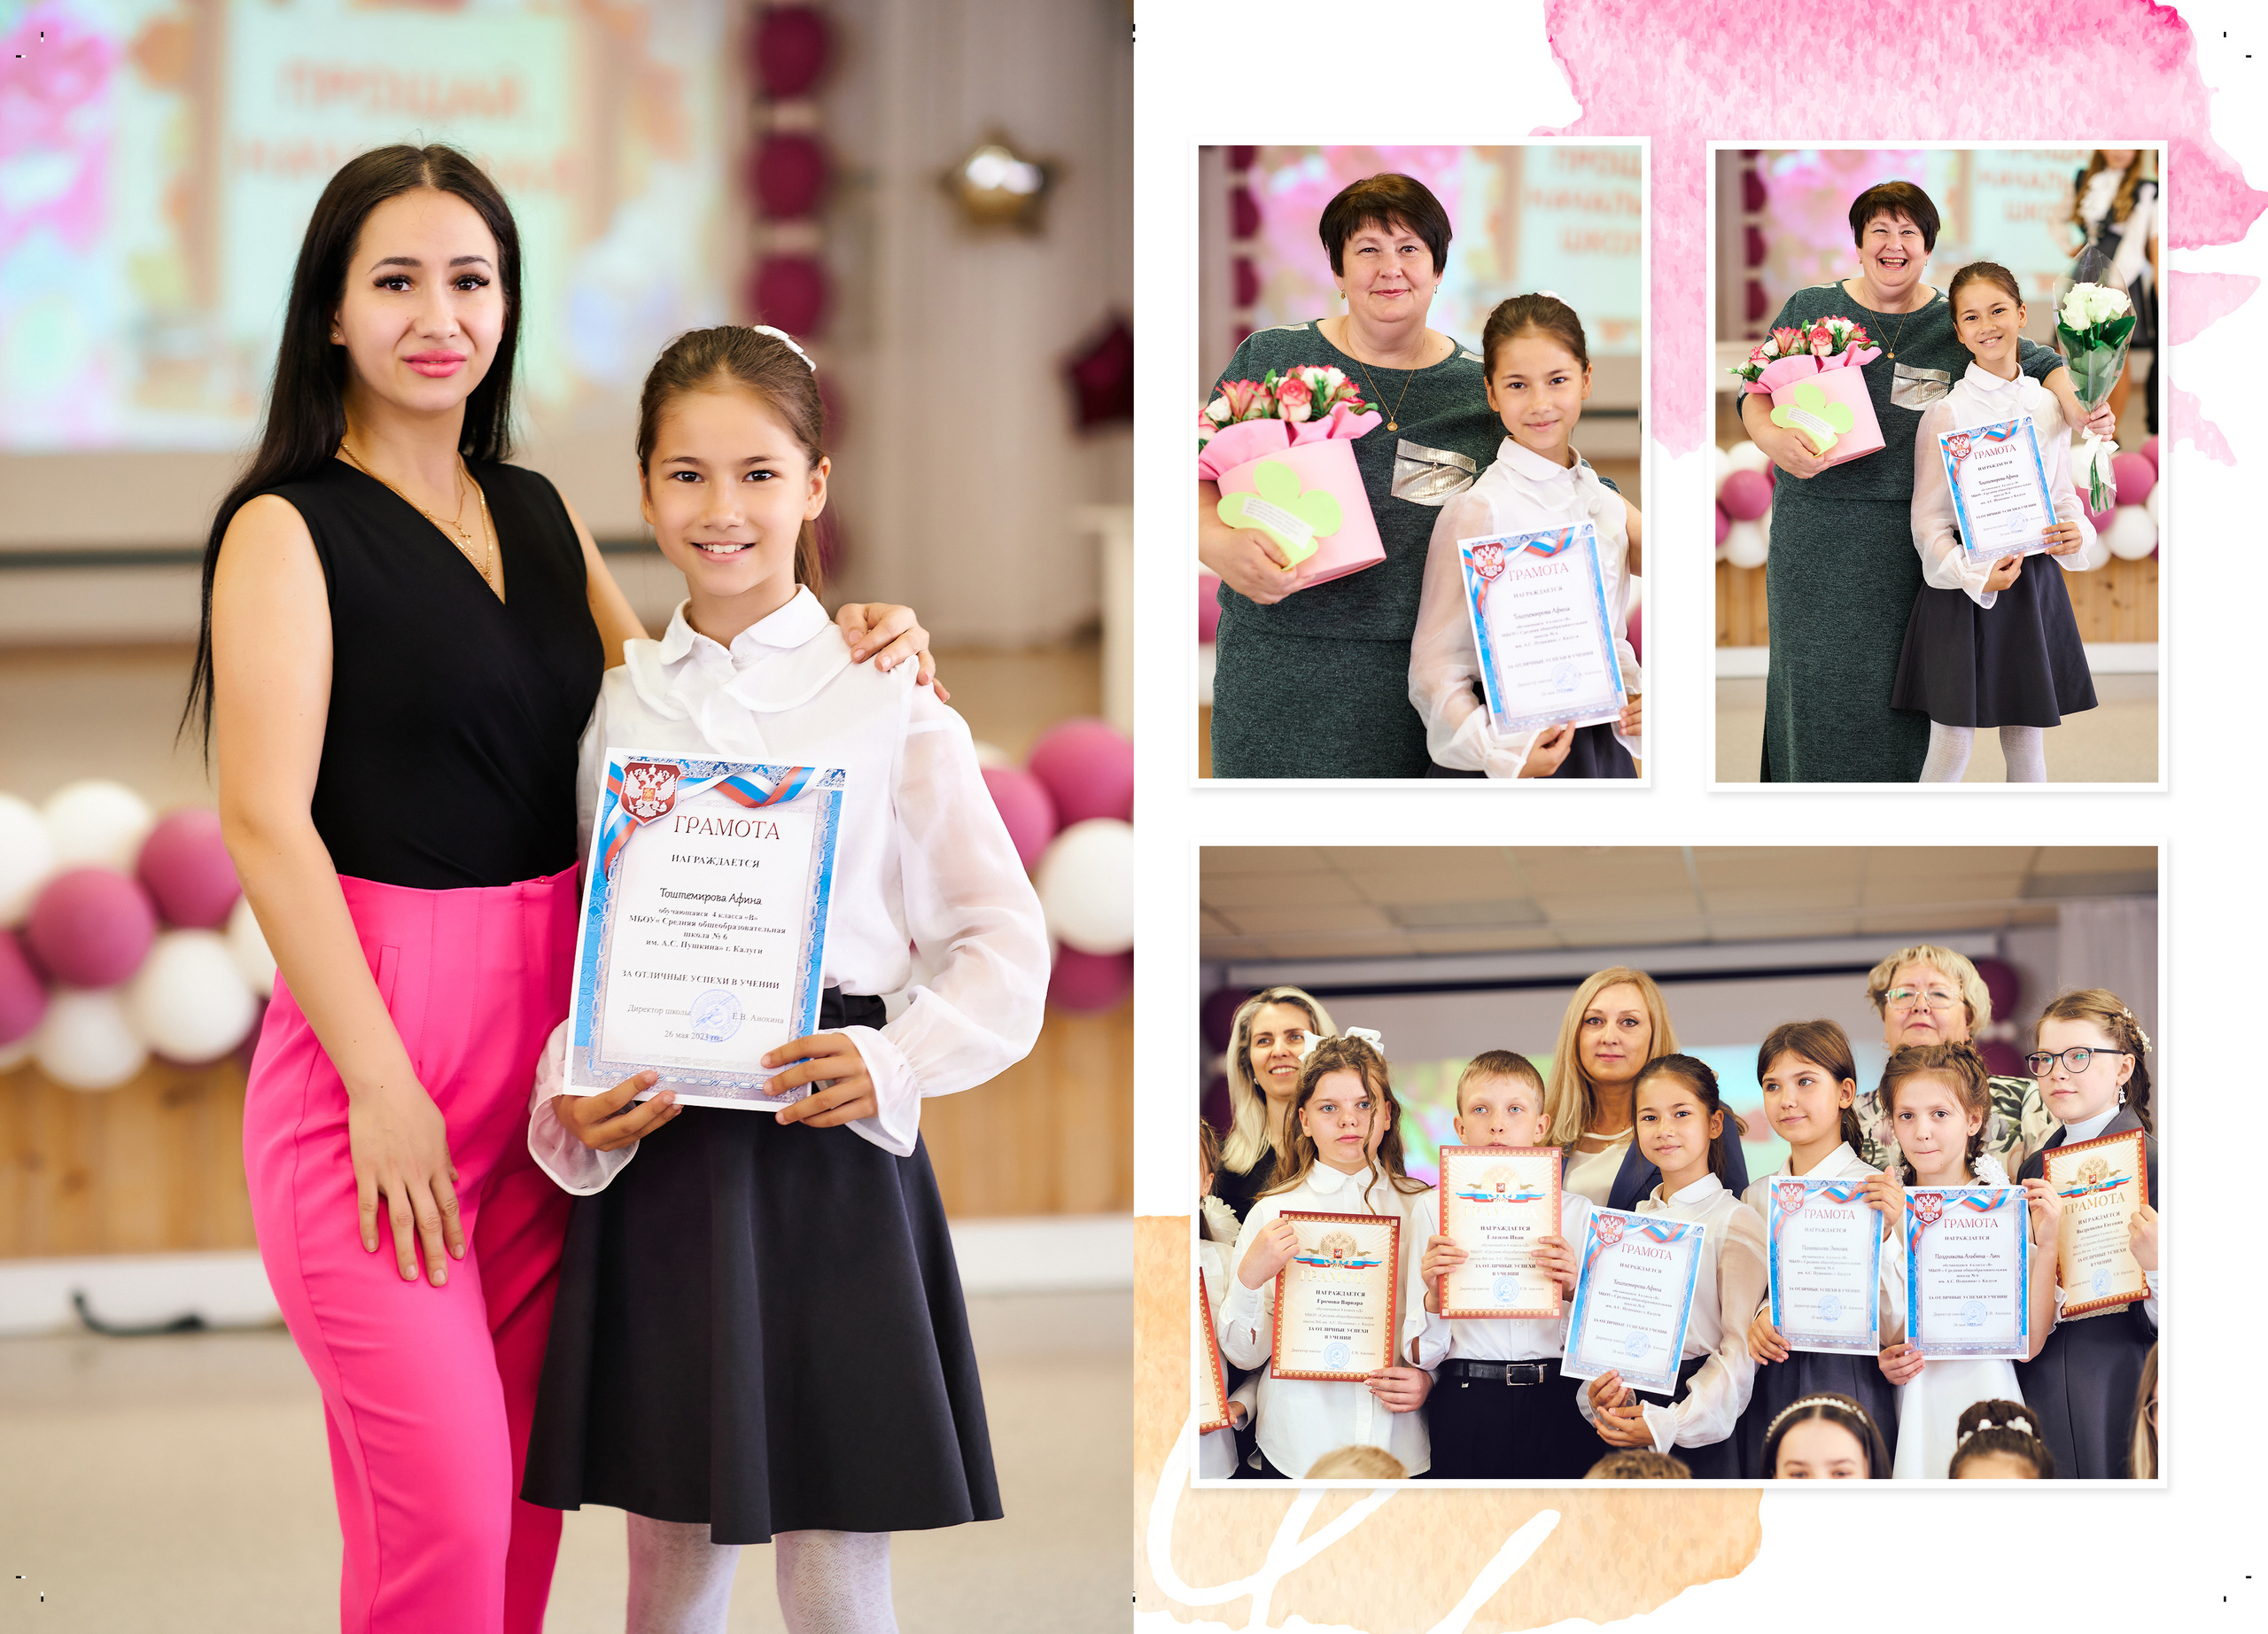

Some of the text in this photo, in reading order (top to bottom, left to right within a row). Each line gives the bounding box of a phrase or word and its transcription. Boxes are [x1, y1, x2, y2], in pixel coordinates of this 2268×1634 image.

[1974, 444, 2016, 460] ГРАМОТА
[1509, 563, 1569, 581] ГРАМОТА
[1513, 586, 1563, 598] НАГРАЖДАЕТСЯ
[674, 815, 781, 840] ГРАМОТА
[672, 853, 760, 868] НАГРАЖДАЕТСЯ
[660, 887, 762, 906] Тоштемирова Афина
[658, 907, 709, 917] обучающаяся
[662, 917, 696, 927] Средняя
[698, 921, 787, 934] общеобразовательная
[734, 945, 763, 955] Калуги
[634, 970, 688, 982] ОТЛИЧНЫЕ
[691, 975, 729, 985] УСПЕХИ
[740, 979, 780, 990] УЧЕНИИ
[627, 1004, 664, 1015] Директор
[732, 1012, 749, 1021] Е.В.
[750, 1015, 784, 1024] Анохина
[691, 1031, 709, 1041] 2023
[2063, 1191, 2126, 1215] ГРАМОТА
[1804, 1209, 1855, 1220] ГРАМОТА
[2078, 1210, 2120, 1226] НАГРАЖДАЕТСЯ
[1805, 1226, 1846, 1234] НАГРАЖДАЕТСЯ
[1944, 1218, 1999, 1229] ГРАМОТА
[1621, 1242, 1673, 1261] ГРАМОТА
[1619, 1262, 1662, 1273] НАГРАЖДАЕТСЯ
[1300, 1270, 1372, 1285] ГРАМОТА
